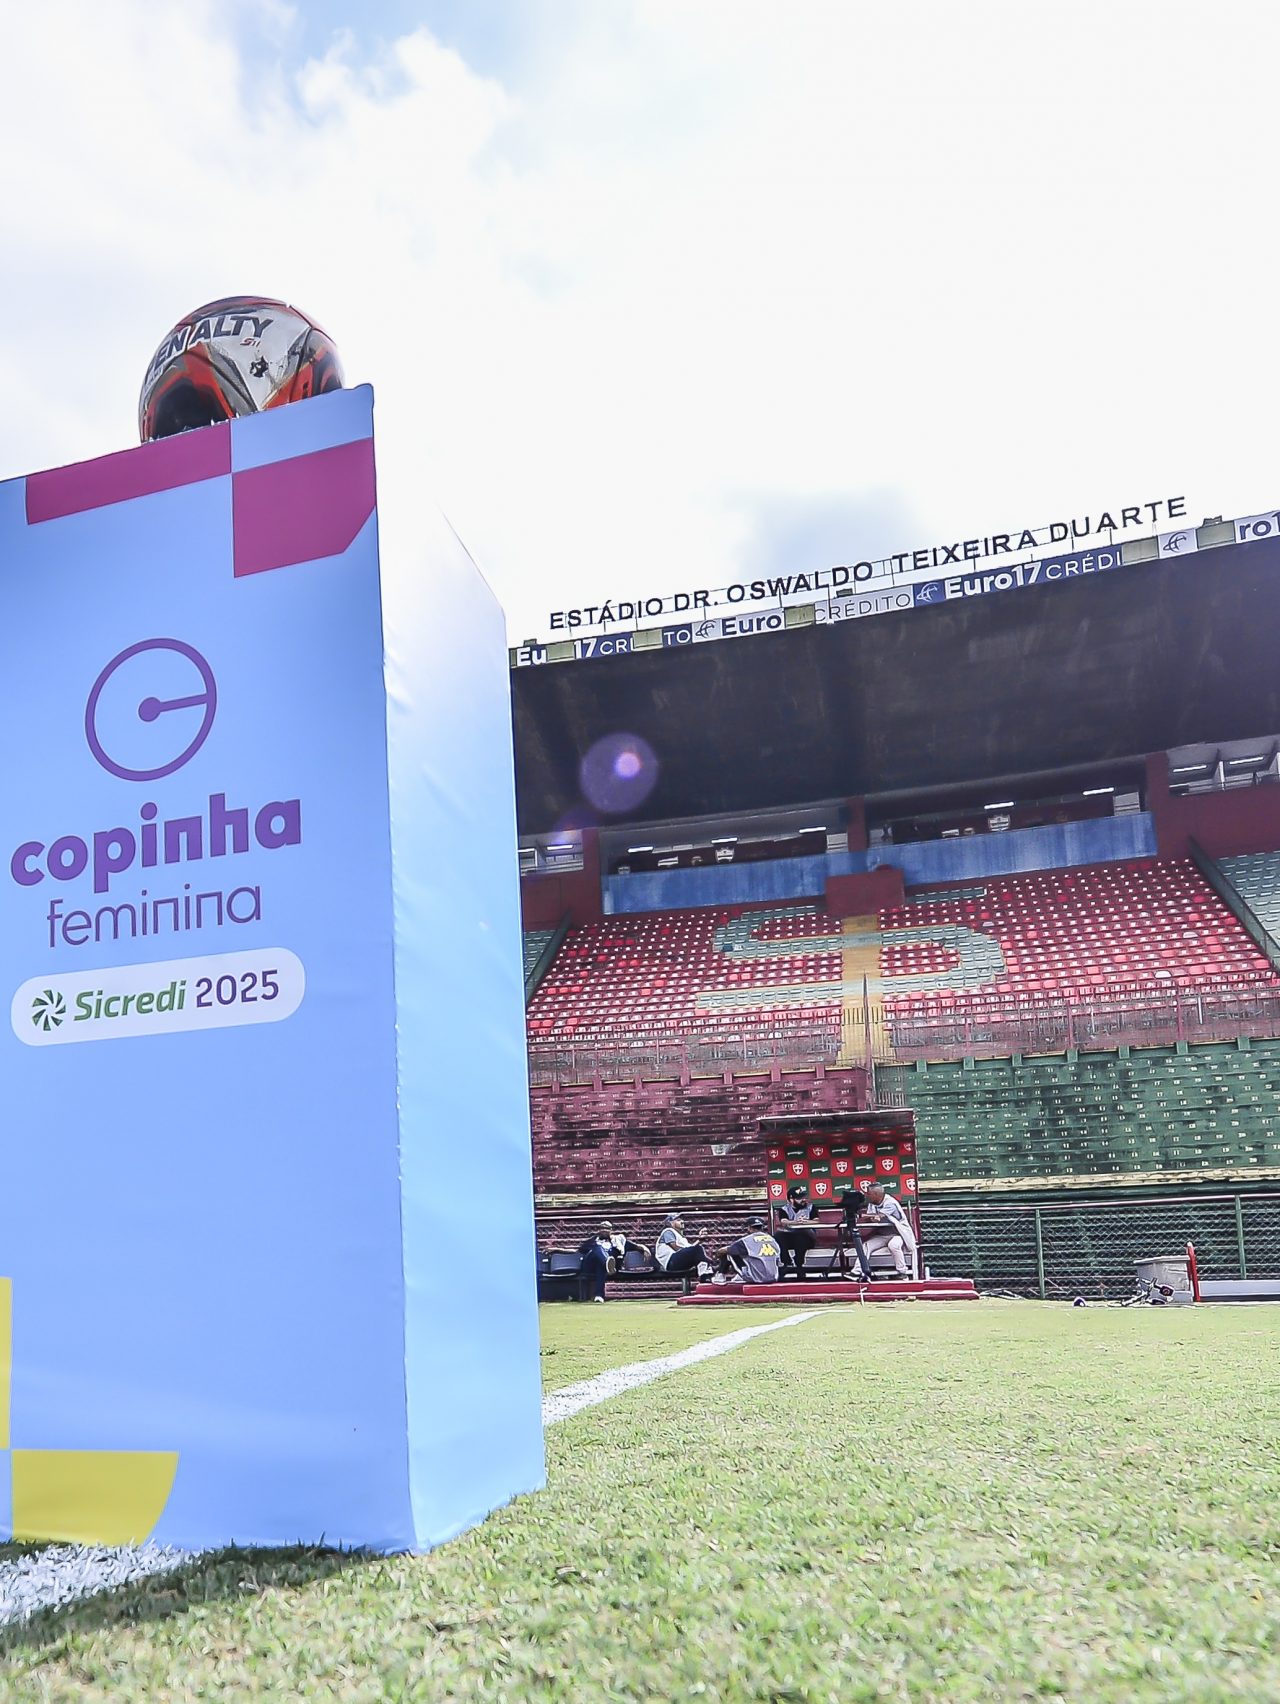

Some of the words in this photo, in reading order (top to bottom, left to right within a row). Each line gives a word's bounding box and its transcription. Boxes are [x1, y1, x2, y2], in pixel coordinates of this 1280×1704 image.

[549, 600, 663, 630] ESTÁDIO
[673, 589, 719, 613] DR.
[726, 561, 873, 604] OSWALDO
[891, 529, 1039, 574] TEIXEIRA
[1050, 496, 1188, 543] DUARTE
[943, 561, 1043, 600] Euro17
[1045, 551, 1122, 580] CRÉDI
[721, 614, 782, 637] Euro
[814, 593, 911, 622] CRÉDITO
[516, 637, 597, 667] Eu17
[599, 629, 691, 656] CRTO
[10, 793, 302, 893] copinha
[47, 883, 261, 947] feminina
[73, 979, 187, 1021] Sicredi
[195, 969, 280, 1008] 2025
